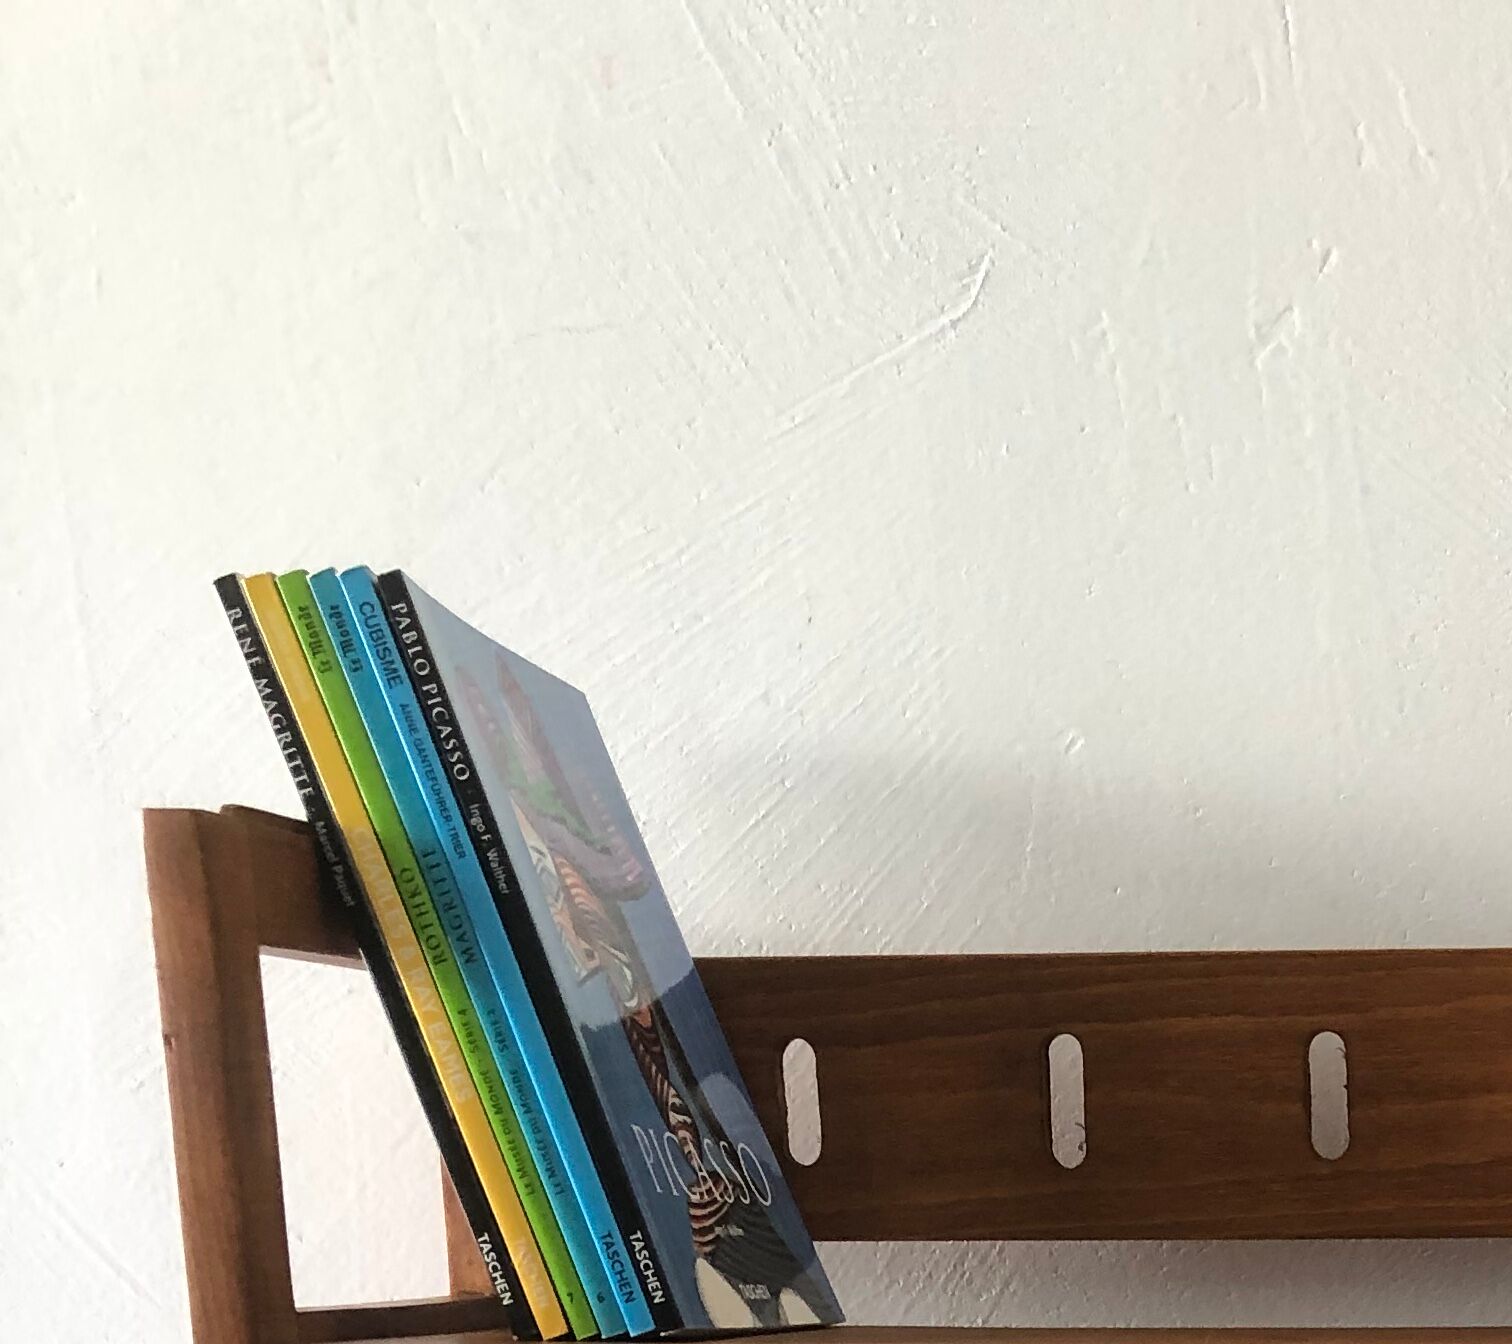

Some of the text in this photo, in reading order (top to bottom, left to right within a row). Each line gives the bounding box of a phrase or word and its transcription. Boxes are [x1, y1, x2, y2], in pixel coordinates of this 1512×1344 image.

[358, 601, 403, 689] CUBISME
[391, 602, 470, 781] PABLO PICASSO
[253, 678, 315, 800] MAGRITTE
[467, 802, 486, 834] Ingo
[486, 847, 511, 895] Walther
[400, 867, 449, 966] ROTHKO
[421, 849, 478, 965] MAGRITTE
[630, 1124, 772, 1206] PICASSO
[477, 1232, 514, 1306] TASCHEN
[599, 1231, 636, 1304] TASCHEN
[629, 1230, 666, 1304] TASCHEN
